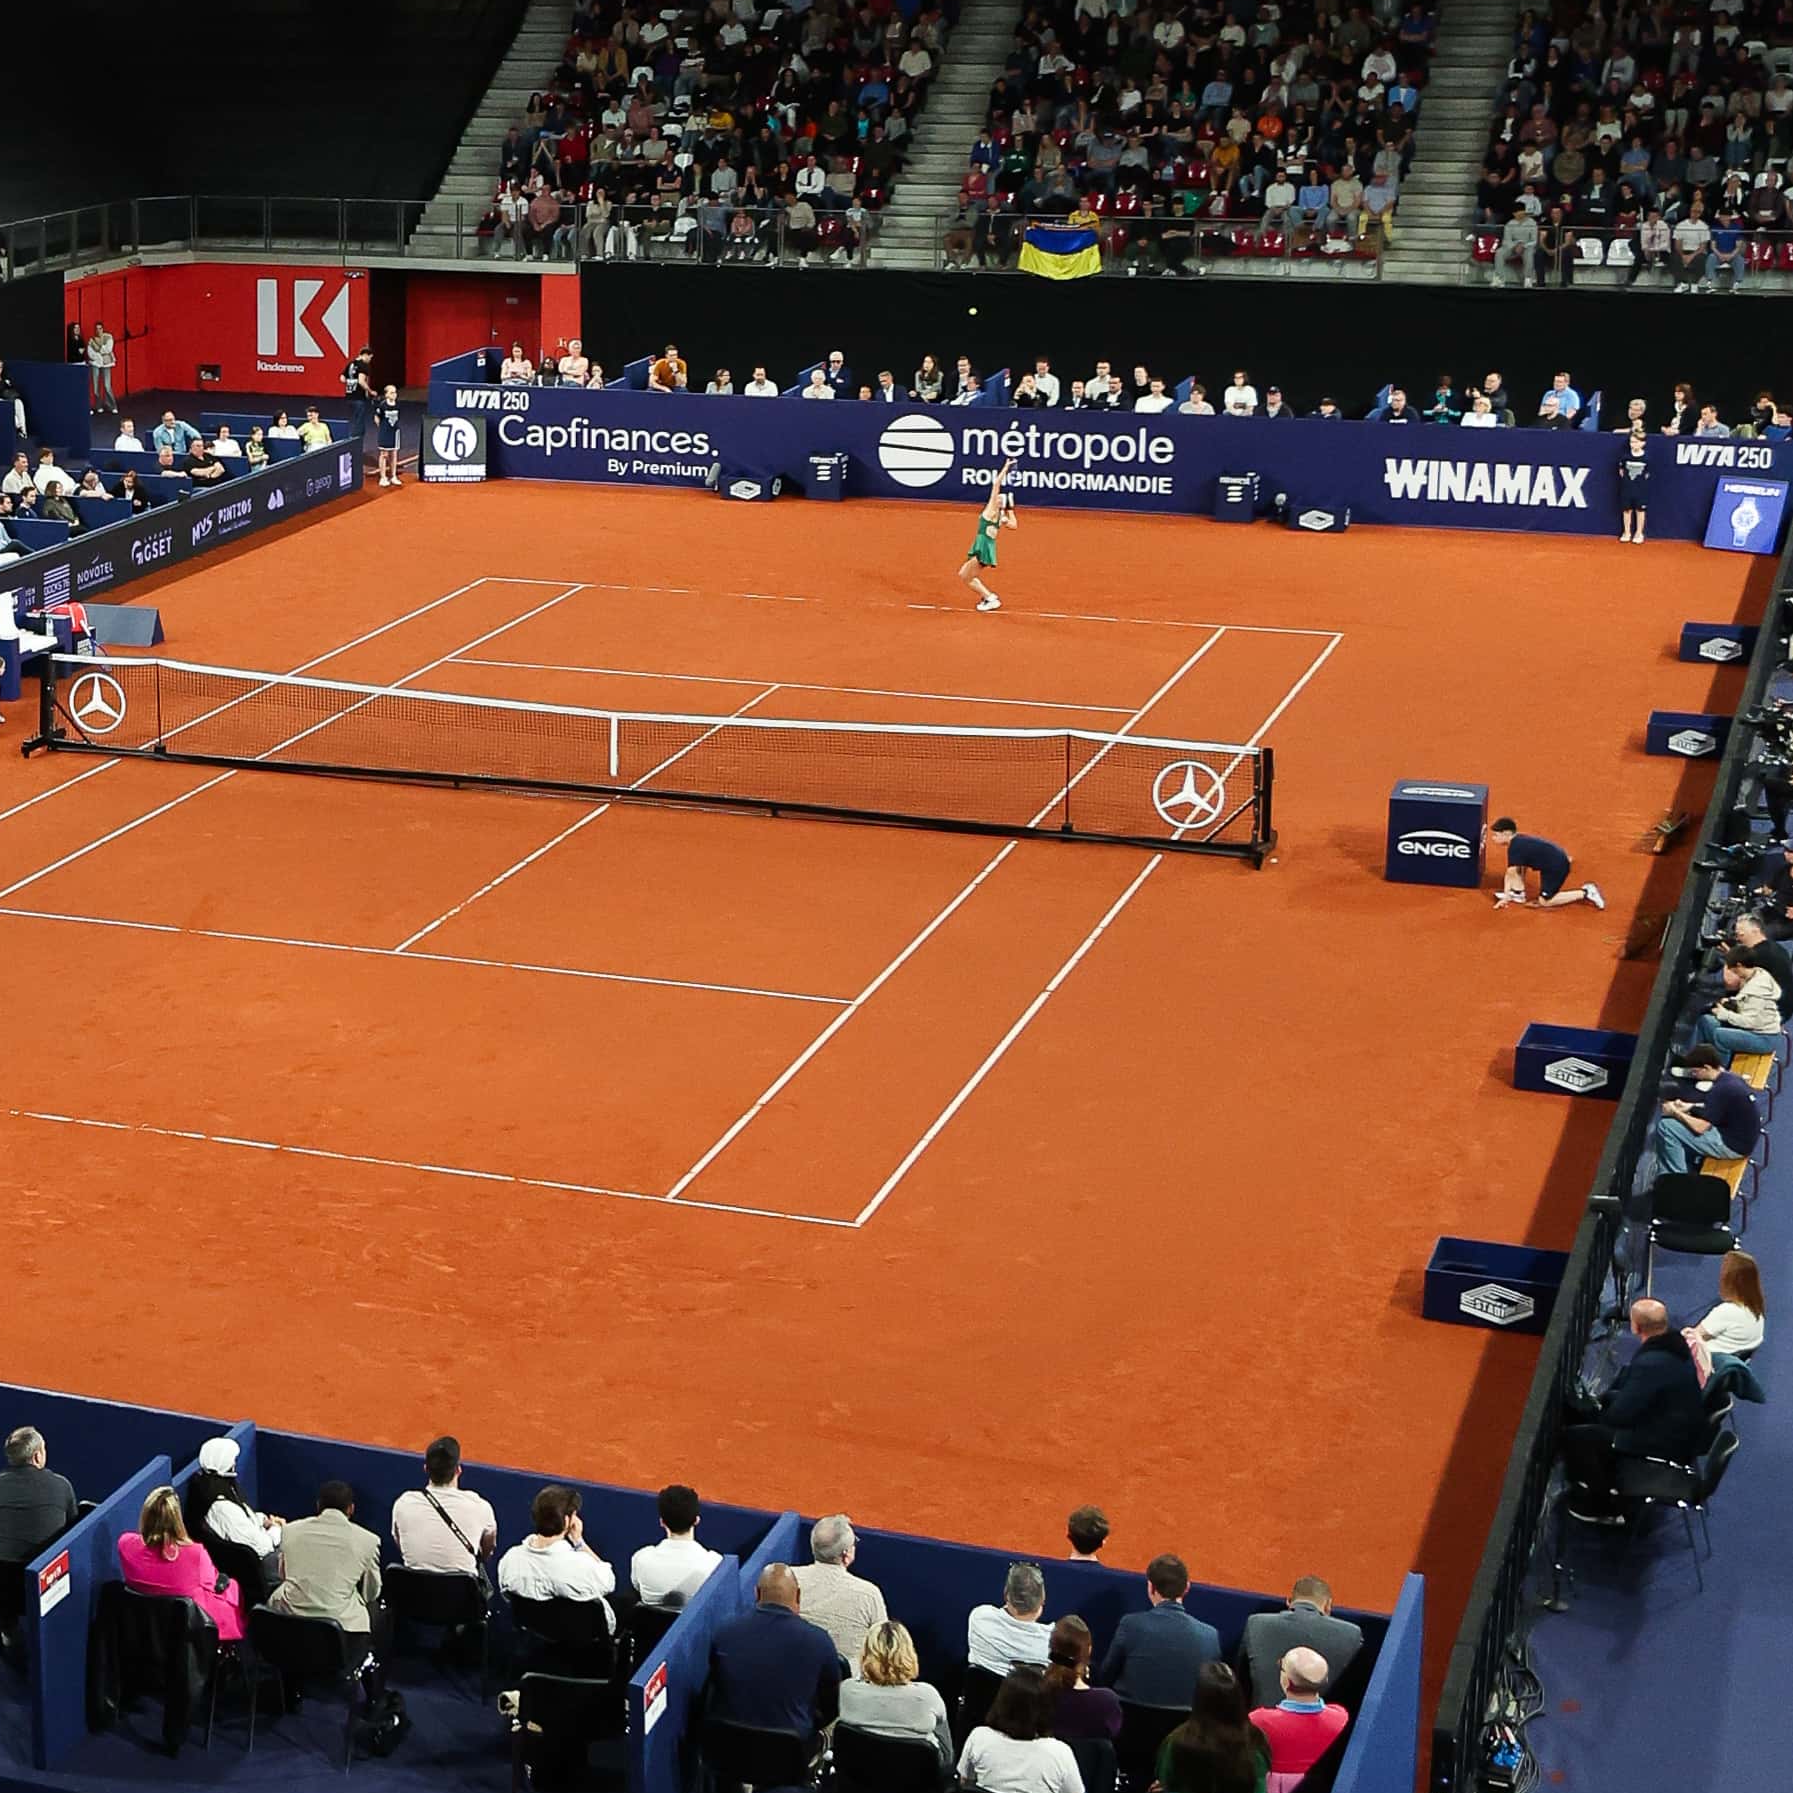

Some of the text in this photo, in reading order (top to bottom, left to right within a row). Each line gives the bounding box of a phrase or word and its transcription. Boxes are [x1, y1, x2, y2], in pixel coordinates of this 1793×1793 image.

[456, 389, 530, 412] WTA 250
[439, 423, 467, 459] 76
[498, 414, 719, 457] Capfinances.
[962, 421, 1175, 470] métropole
[608, 459, 708, 478] By Premium
[1676, 443, 1772, 469] WTA 250
[1384, 457, 1591, 509] WINAMAX
[77, 561, 114, 585] NOVOTEL
